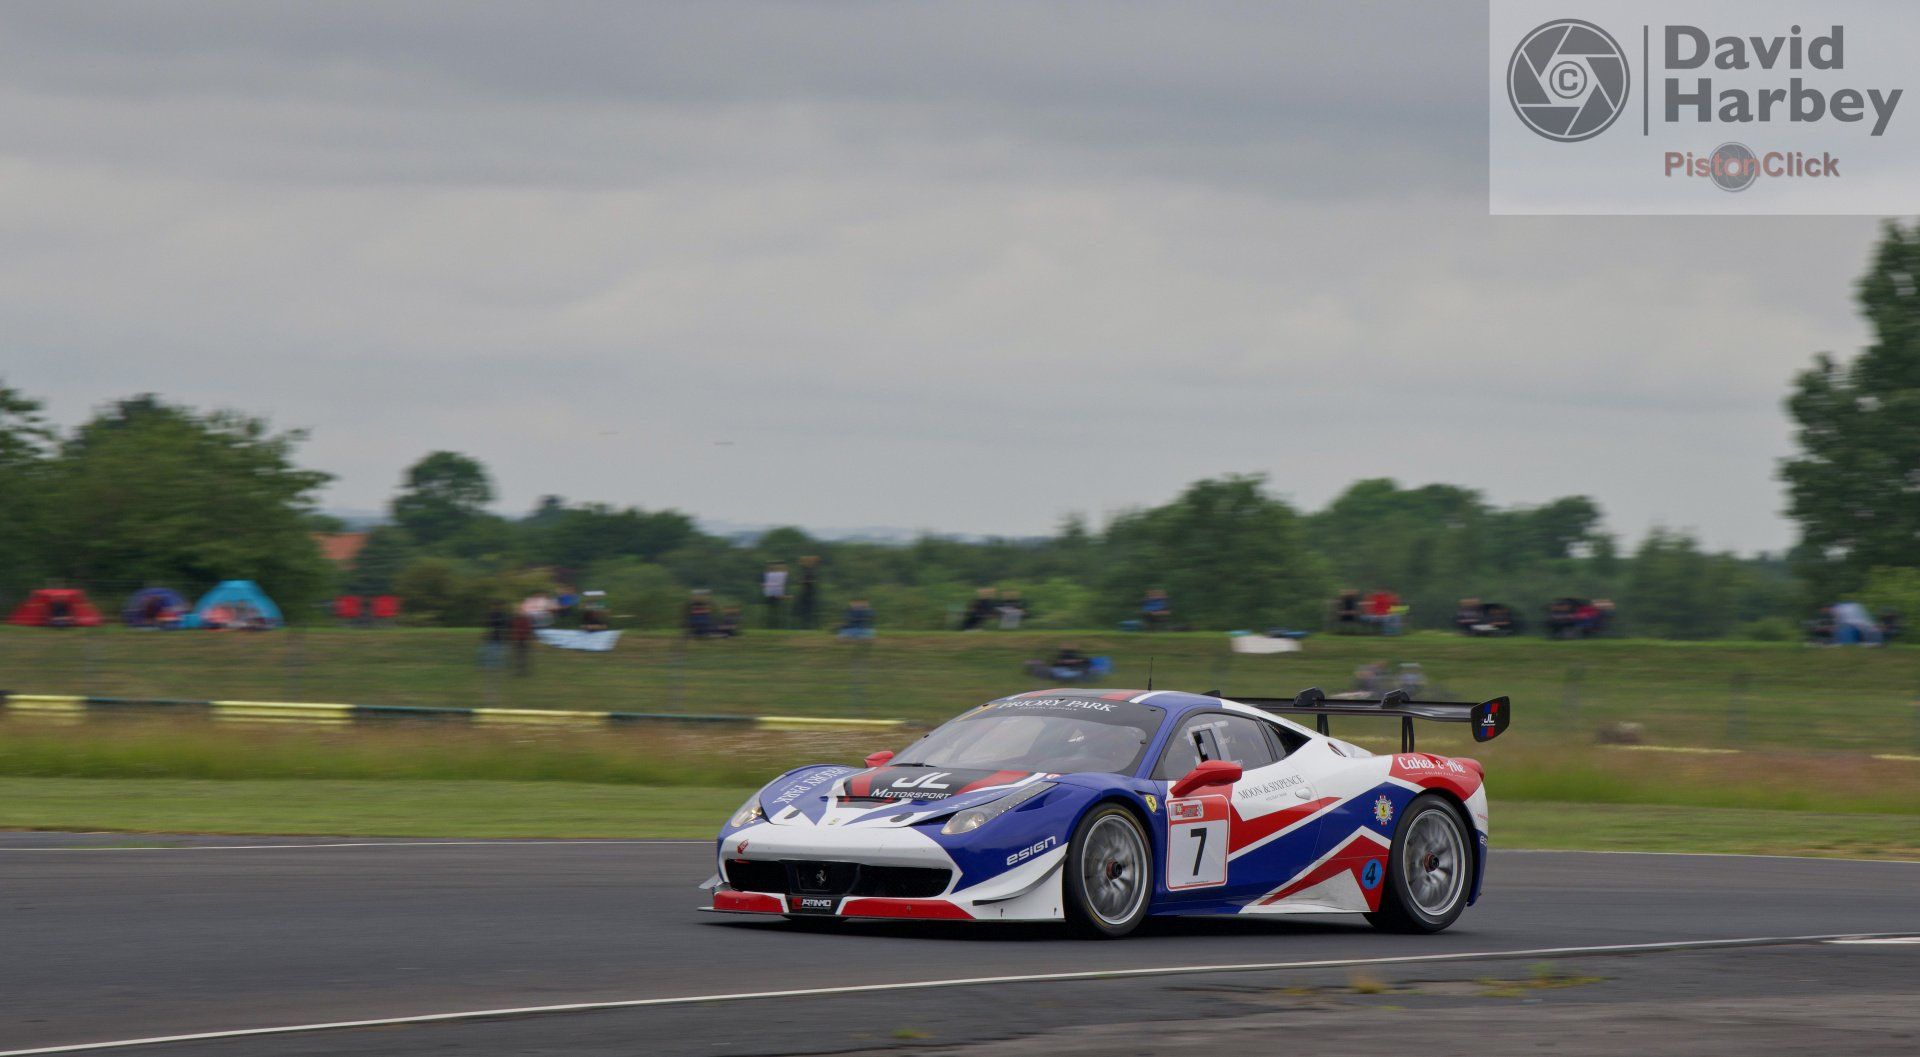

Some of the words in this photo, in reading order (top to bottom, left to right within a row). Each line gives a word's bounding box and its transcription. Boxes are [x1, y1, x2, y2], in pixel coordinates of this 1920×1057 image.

[998, 699, 1064, 709] PRIORY
[1066, 700, 1119, 712] PARK
[1397, 756, 1435, 770] Cakes
[1238, 786, 1263, 800] MOON
[1268, 774, 1305, 791] SIXPENCE
[1190, 827, 1207, 876] 7
[1365, 862, 1376, 885] 4
